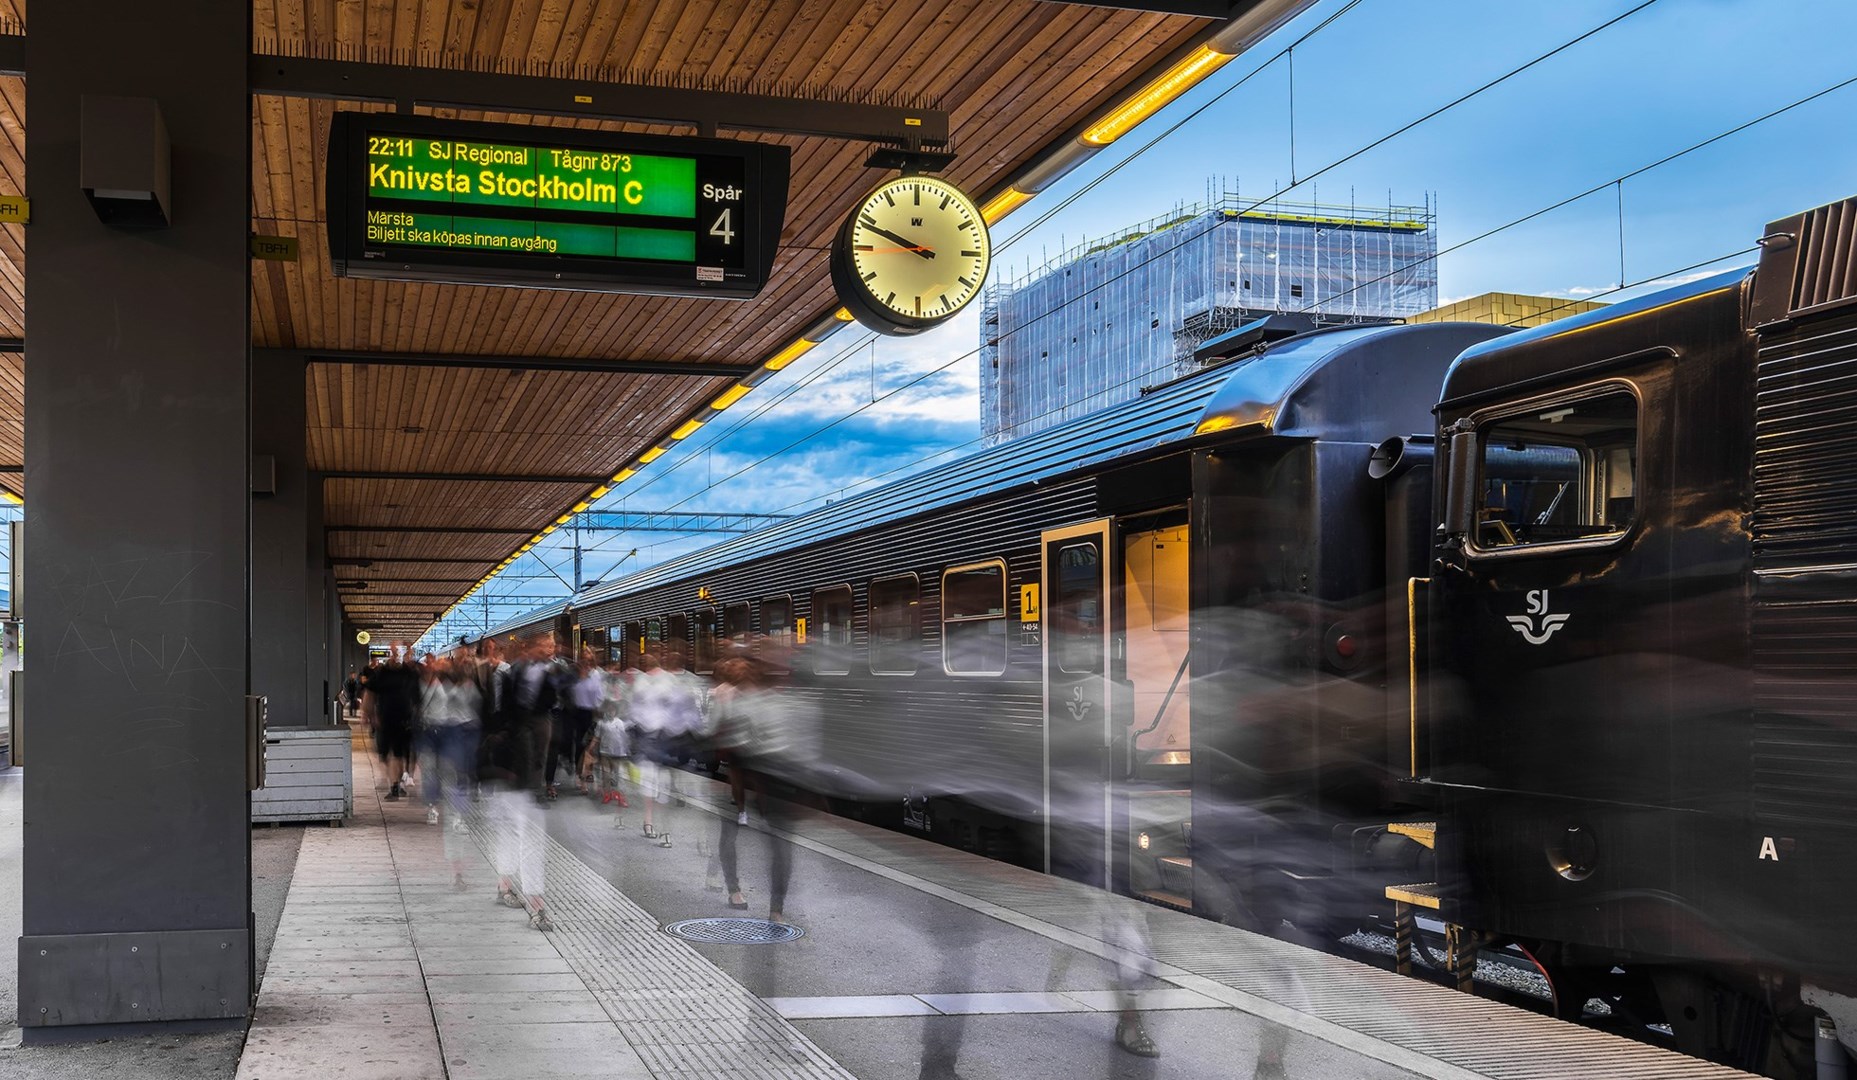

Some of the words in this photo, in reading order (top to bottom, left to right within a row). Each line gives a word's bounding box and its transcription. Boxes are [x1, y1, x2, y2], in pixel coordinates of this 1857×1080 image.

[369, 137, 413, 157] 22:11
[428, 141, 451, 160] SJ
[455, 143, 528, 166] Regional
[551, 149, 598, 173] Tågnr
[600, 153, 632, 173] 873
[370, 163, 471, 194] Knivsta
[479, 170, 616, 203] Stockholm
[624, 180, 643, 205] C
[702, 183, 743, 203] Spår
[0, 203, 19, 216] FH
[367, 210, 414, 227] Märsta
[709, 203, 735, 245] 4
[259, 242, 289, 255] TBFH
[367, 225, 406, 243] Biljett
[407, 228, 431, 242] ska
[433, 229, 472, 247] köpas
[474, 231, 508, 247] innan
[510, 235, 557, 253] avgång
[1025, 590, 1034, 615] 1
[1526, 589, 1549, 616] SJ
[1073, 686, 1083, 702] SJ
[1758, 836, 1779, 861] A
